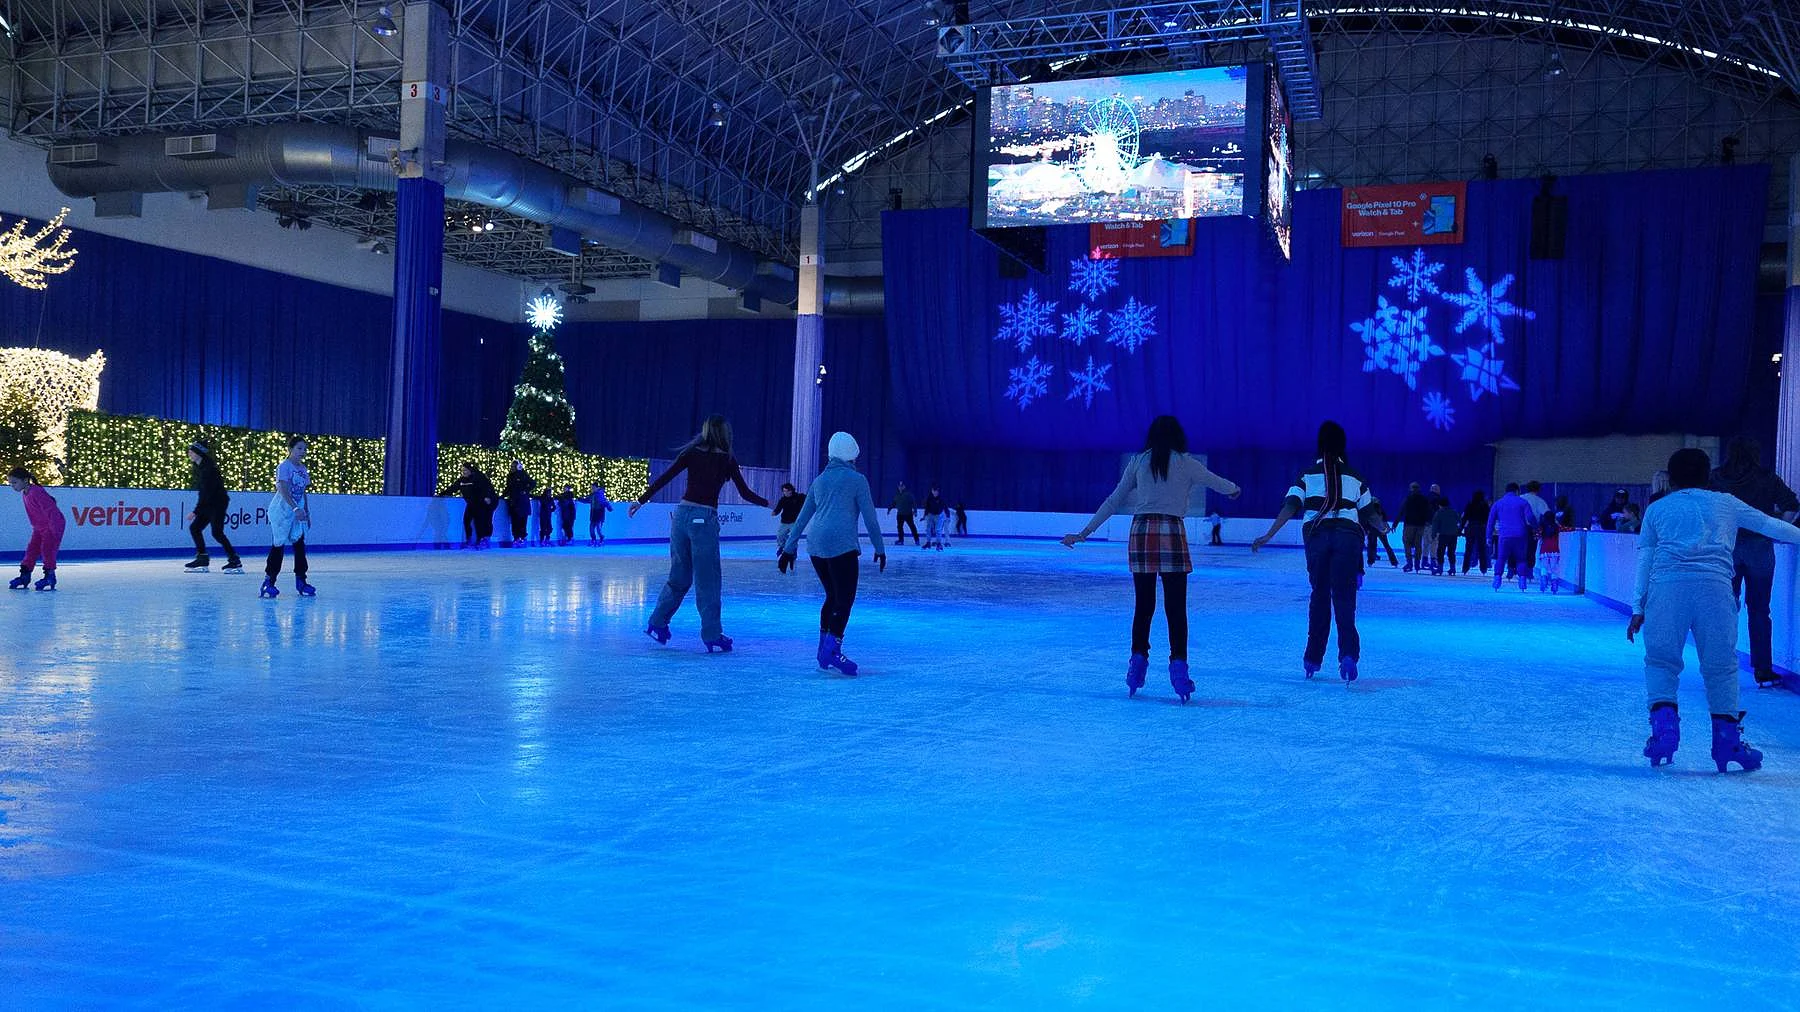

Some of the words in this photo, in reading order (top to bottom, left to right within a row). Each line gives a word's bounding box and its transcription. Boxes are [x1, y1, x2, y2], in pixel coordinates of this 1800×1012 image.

[410, 83, 418, 98] 3
[434, 86, 440, 101] 3
[1346, 202, 1373, 210] Google
[1373, 201, 1392, 209] Pixel
[1393, 200, 1402, 208] 10
[1402, 200, 1417, 208] Pro
[1359, 209, 1382, 217] Watch
[1104, 223, 1125, 231] Watch
[1131, 221, 1144, 229] Tab
[806, 255, 810, 264] 1
[71, 500, 170, 527] verizon
[224, 507, 252, 530] ogle
